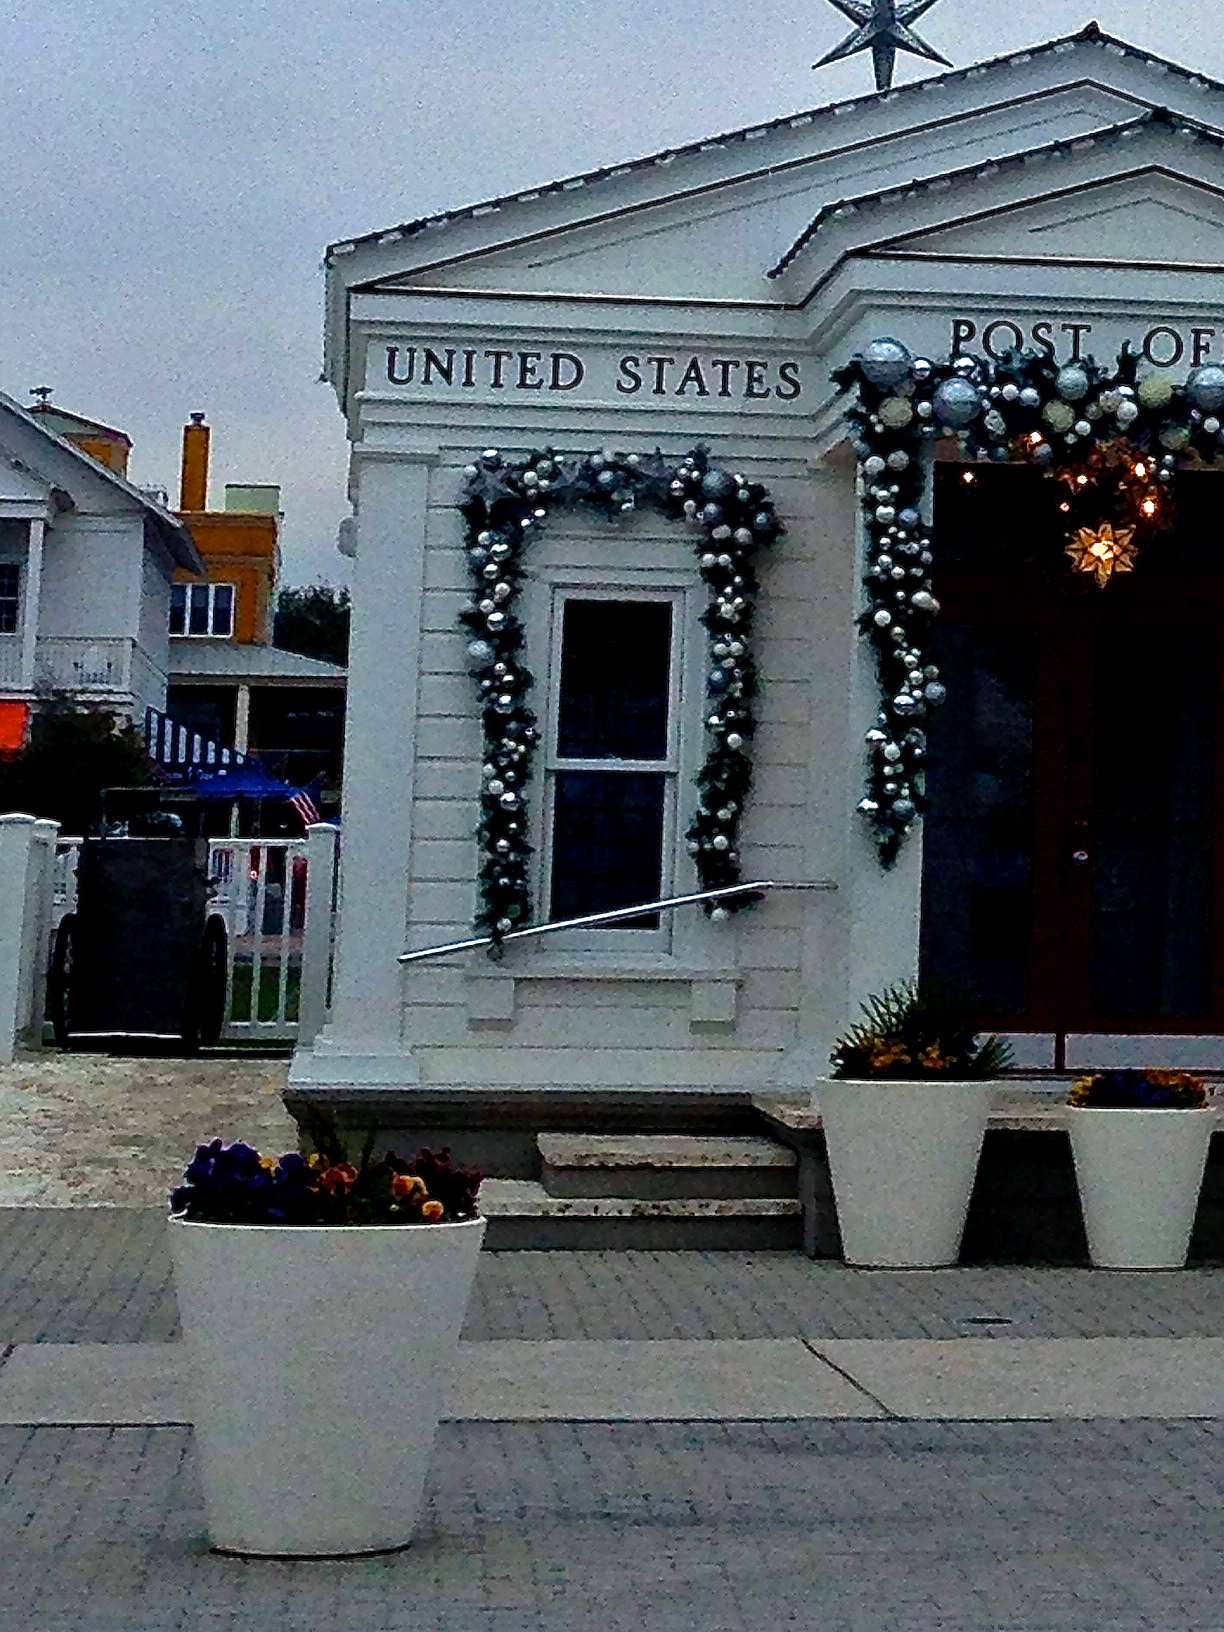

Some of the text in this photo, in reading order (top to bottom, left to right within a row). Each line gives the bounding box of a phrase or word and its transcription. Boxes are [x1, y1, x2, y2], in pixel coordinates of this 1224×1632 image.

[952, 319, 1092, 364] POST
[387, 347, 802, 400] UNITED STATES
